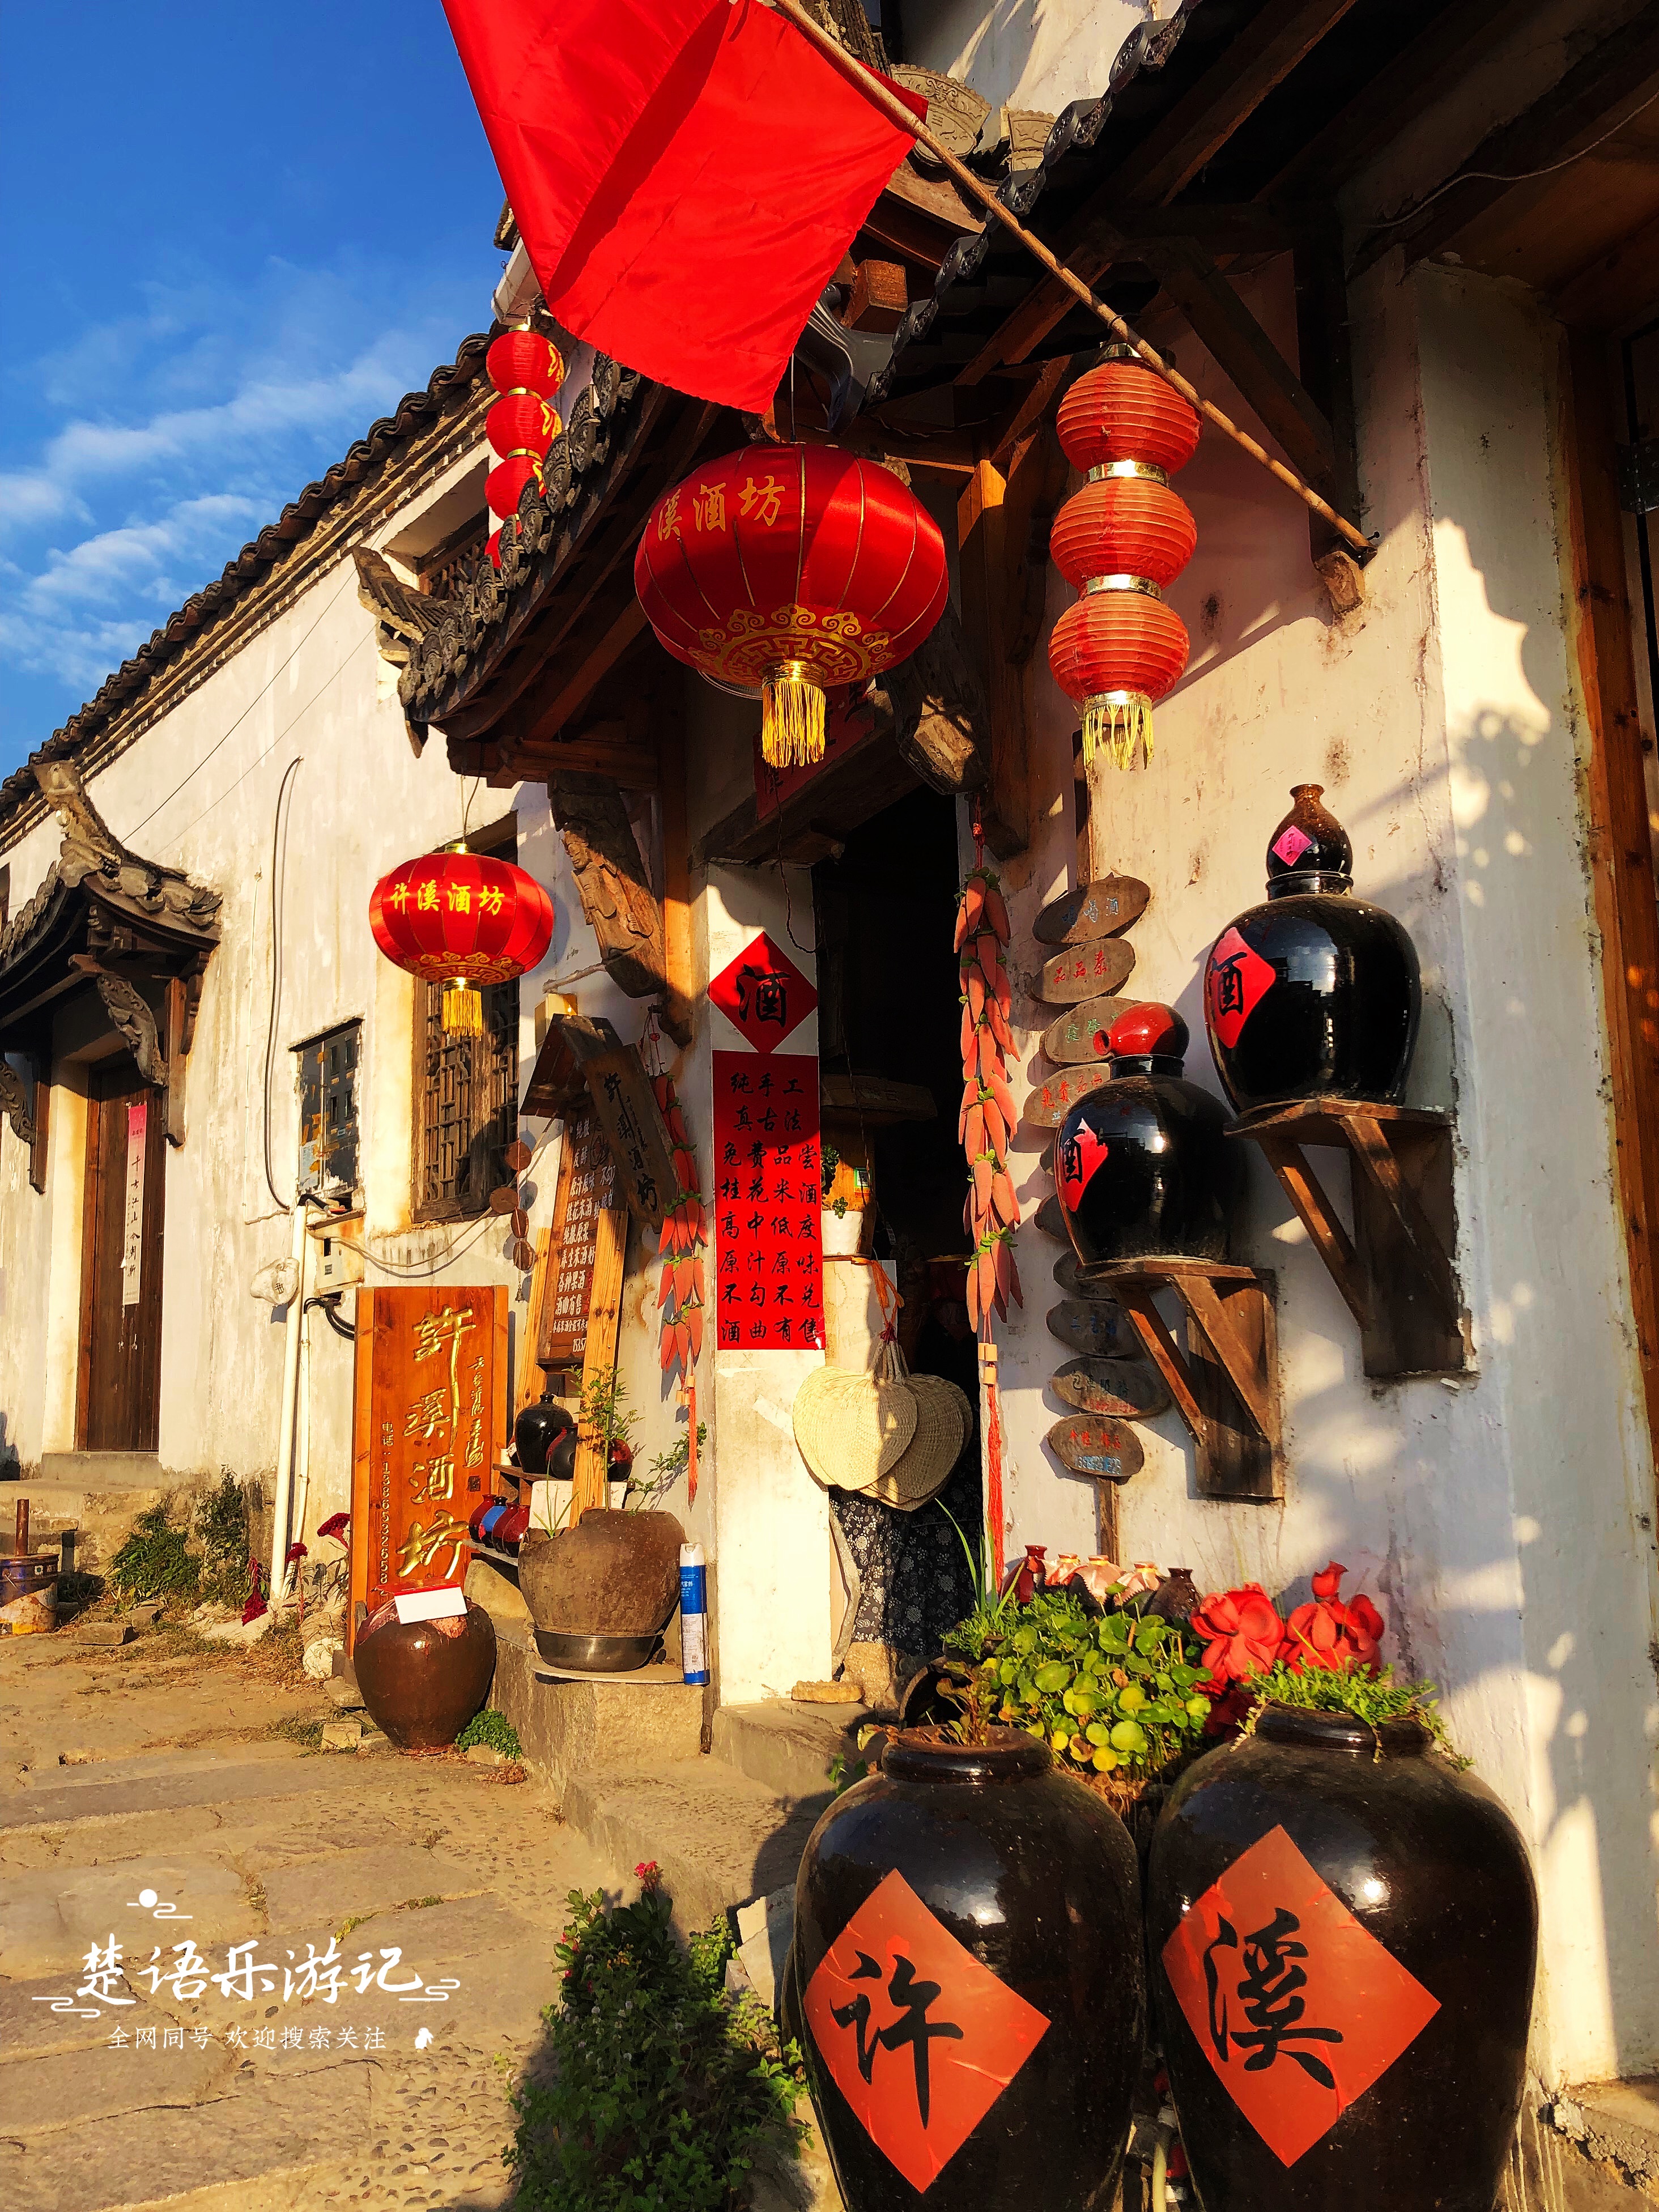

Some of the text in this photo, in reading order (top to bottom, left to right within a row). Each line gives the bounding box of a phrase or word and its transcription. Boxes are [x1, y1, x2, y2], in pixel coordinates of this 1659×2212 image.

[648, 475, 785, 542] 溪酒坊
[390, 879, 505, 916] 许溪酒坊
[1053, 949, 1108, 985] 品品茶
[735, 963, 791, 1028] 酒
[1207, 951, 1248, 1016] 酒
[730, 1071, 805, 1098] 纯手工
[733, 1104, 803, 1132] 真古法
[722, 1139, 818, 1171] 免费品尝
[569, 1171, 595, 1197] 原汁原味
[719, 1175, 818, 1206] 桂花米酒
[566, 1197, 593, 1223] 桂花米酒
[720, 1210, 818, 1241] 高中低度
[719, 1249, 819, 1276] 原汁原味
[558, 1269, 586, 1293] 各种果酒
[721, 1280, 820, 1308] 不勾不兑
[555, 1293, 582, 1316] 酒曲有售
[720, 1316, 819, 1345] 酒曲有售
[1202, 1907, 1345, 2090] 溪
[829, 1950, 965, 2130] 许
